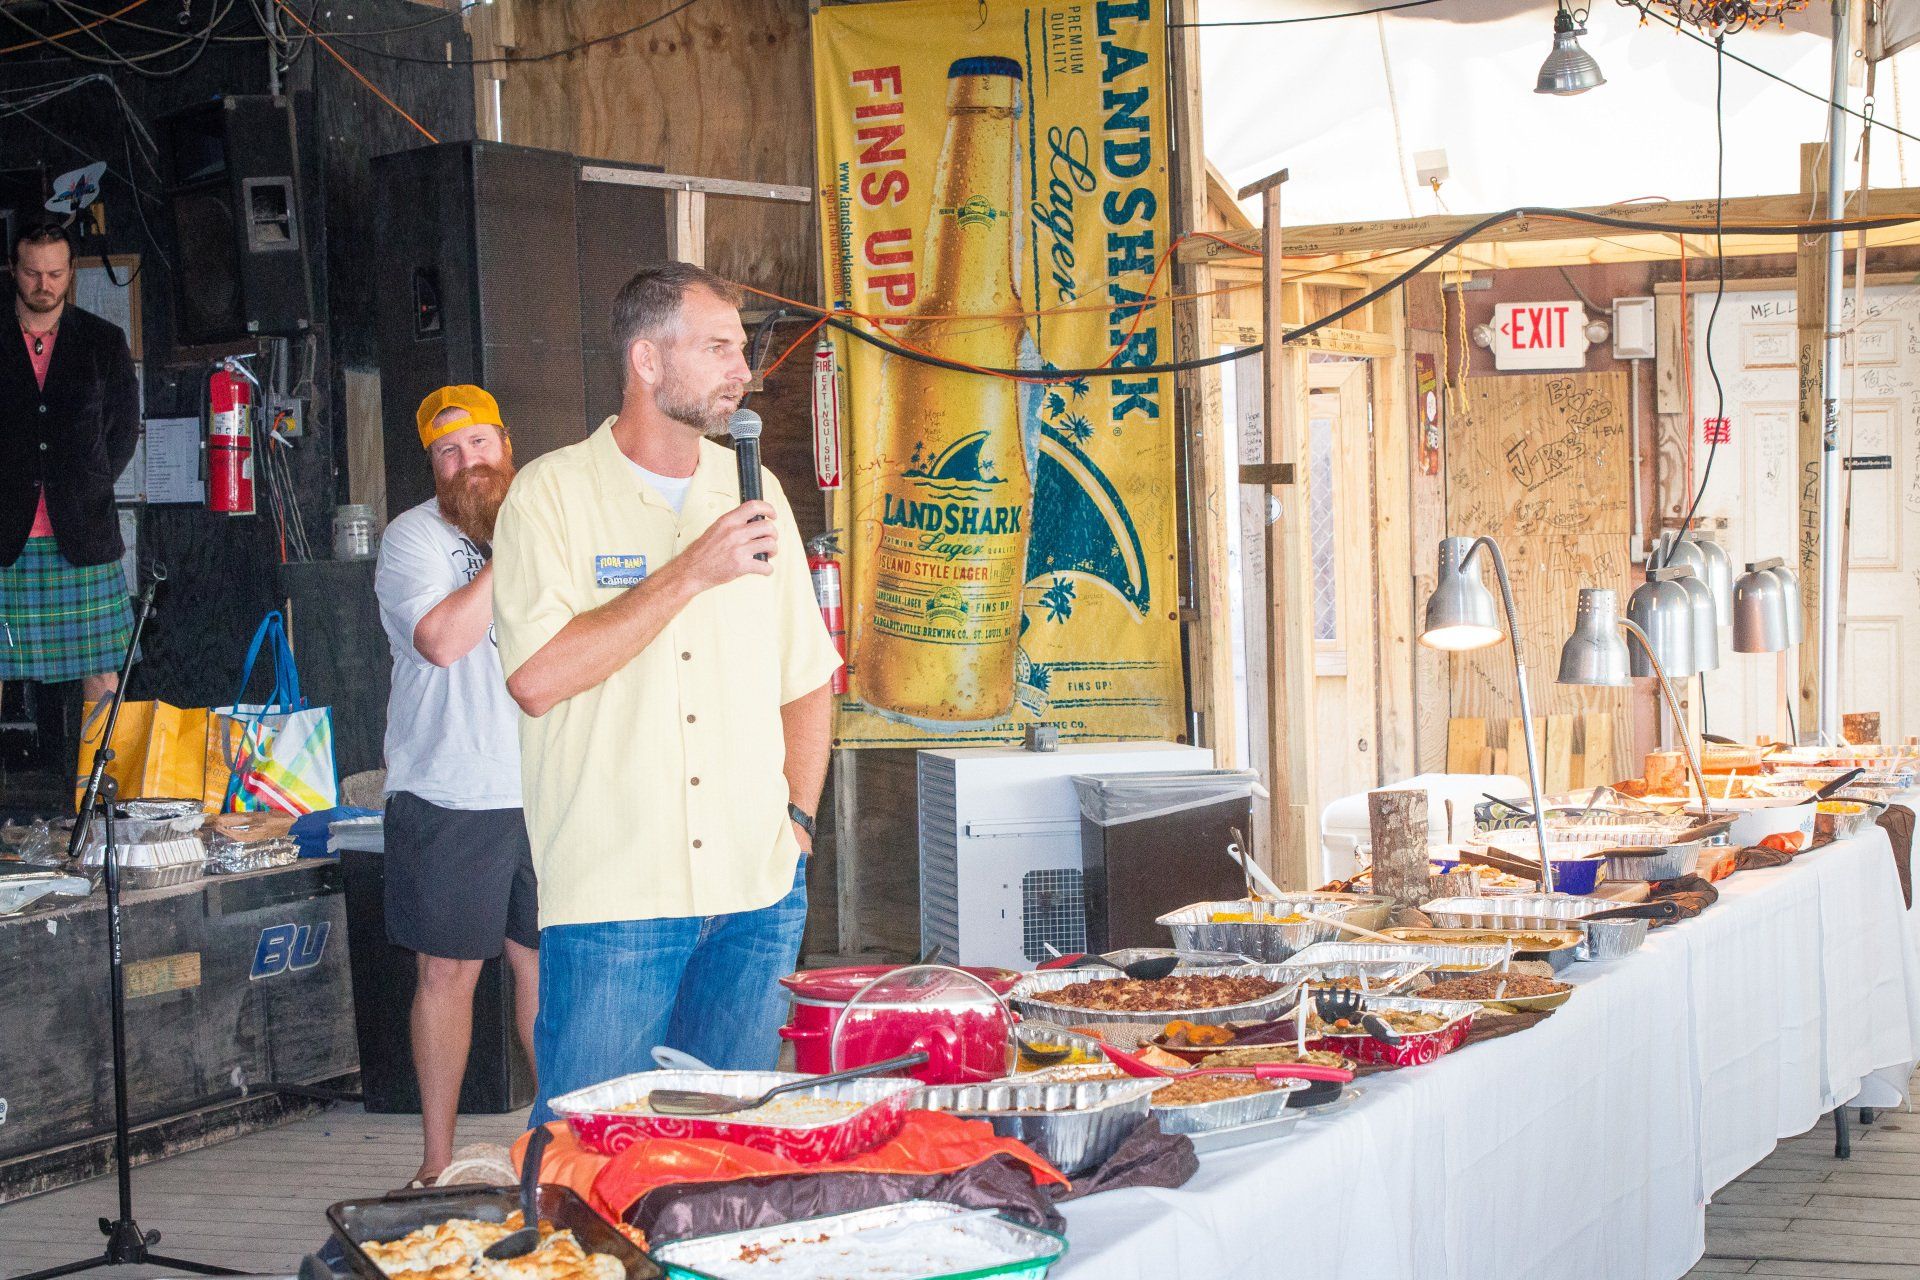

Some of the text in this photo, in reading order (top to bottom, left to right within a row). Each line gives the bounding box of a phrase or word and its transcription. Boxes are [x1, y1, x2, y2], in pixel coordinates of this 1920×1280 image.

[1050, 12, 1067, 74] QUALITY
[1067, 5, 1084, 74] PREMIUM
[852, 65, 910, 206] FINS
[1031, 126, 1097, 303] Lager
[1096, 0, 1159, 421] LANDSHARK
[839, 161, 853, 329] www.landsharklager.cm
[1512, 306, 1569, 349] EXIT
[815, 360, 833, 372] FIRE
[821, 375, 831, 480] EXTINGUISHER
[1592, 425, 1624, 439] 4-EVA
[883, 493, 1022, 536] LANDSHARK
[878, 554, 911, 574] ISLAND
[914, 563, 949, 579] STYLE
[953, 566, 988, 580] LAGER
[918, 533, 985, 562] Lager
[904, 596, 922, 608] LAGER
[975, 602, 997, 613] FINS
[873, 614, 921, 635] MARGARITAVILLE
[922, 627, 956, 639] BREWING
[1068, 681, 1113, 692] FINS UP!
[1071, 721, 1088, 729] CO.
[249, 921, 331, 980] BU
